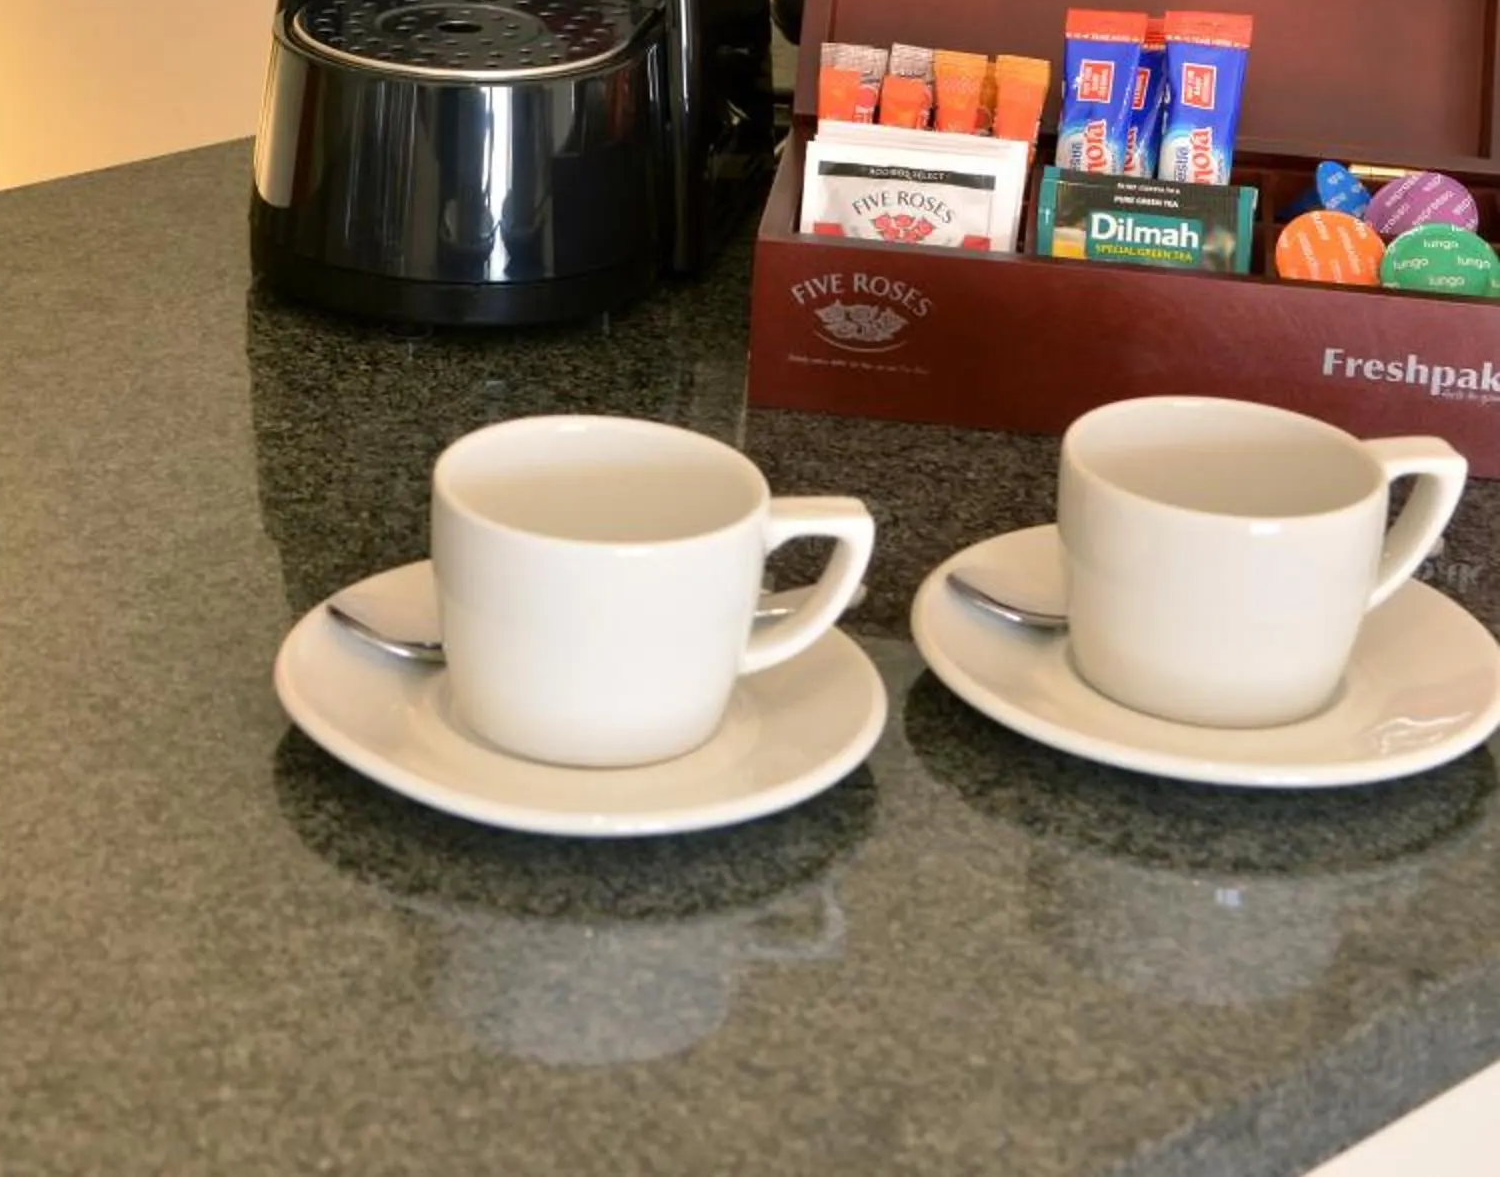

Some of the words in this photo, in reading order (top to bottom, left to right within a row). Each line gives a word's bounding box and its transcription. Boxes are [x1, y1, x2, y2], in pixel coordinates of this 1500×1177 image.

[851, 191, 894, 215] FIVE
[897, 190, 955, 224] ROSES
[1091, 212, 1199, 249] Dilmah
[1423, 237, 1459, 250] lungo
[1096, 242, 1135, 257] SPECIAL
[1136, 247, 1171, 260] GREEN
[1171, 251, 1193, 263] TEA
[1393, 256, 1429, 270] lungo
[1457, 254, 1491, 270] lungo
[789, 273, 844, 305] FIVE
[853, 272, 933, 317] ROSES
[1322, 346, 1500, 397] Freshpak
